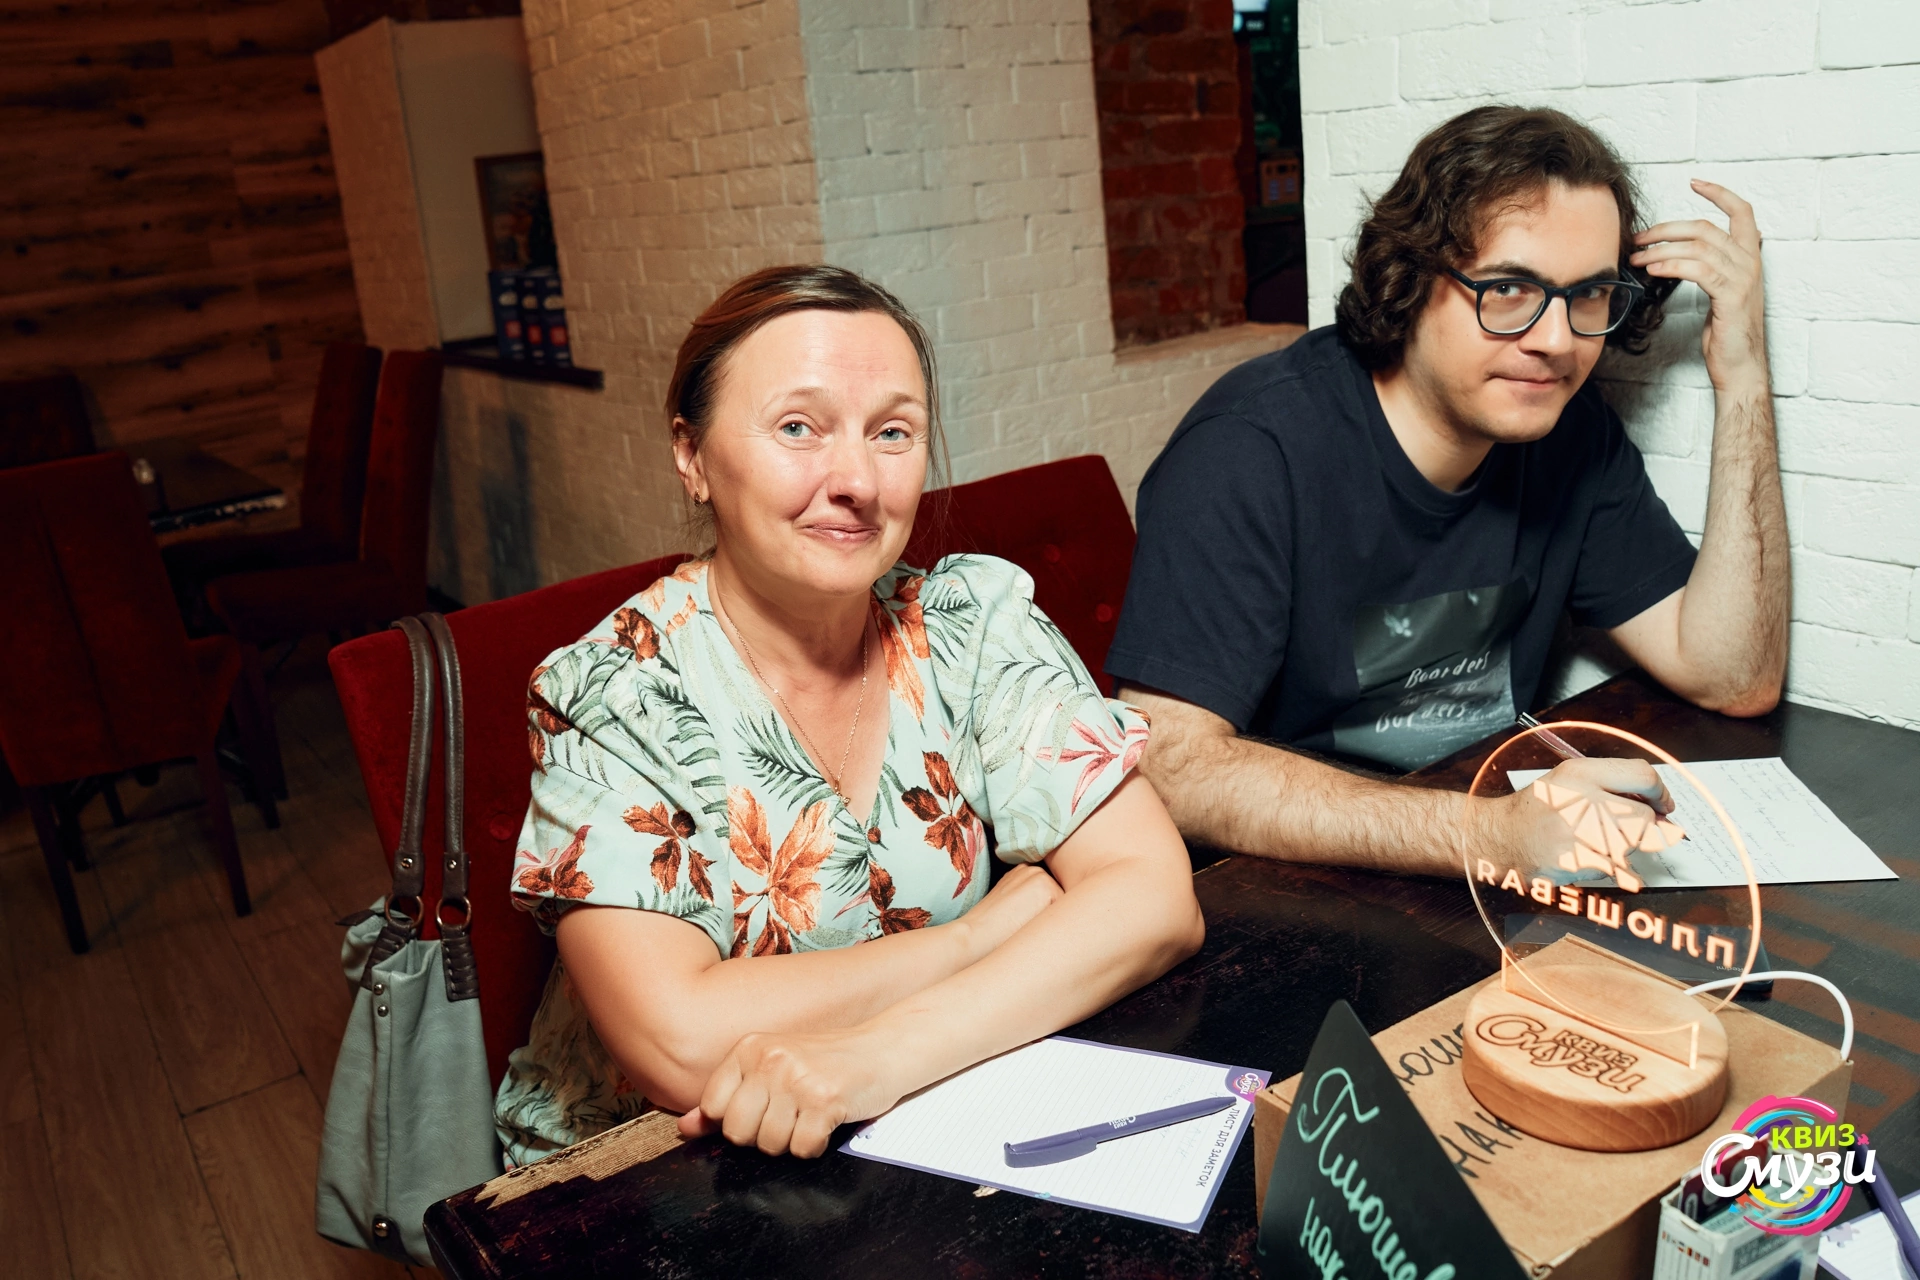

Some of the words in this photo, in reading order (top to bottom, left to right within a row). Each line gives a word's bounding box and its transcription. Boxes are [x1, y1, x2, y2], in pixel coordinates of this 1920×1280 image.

[1476, 1014, 1647, 1094] Смузи
[1554, 1030, 1638, 1068] КВИЗ
[1223, 1108, 1240, 1131] ЛИСТ
[1215, 1130, 1230, 1148] ДЛЯ
[1196, 1149, 1222, 1188] ЗАМЕТОК
